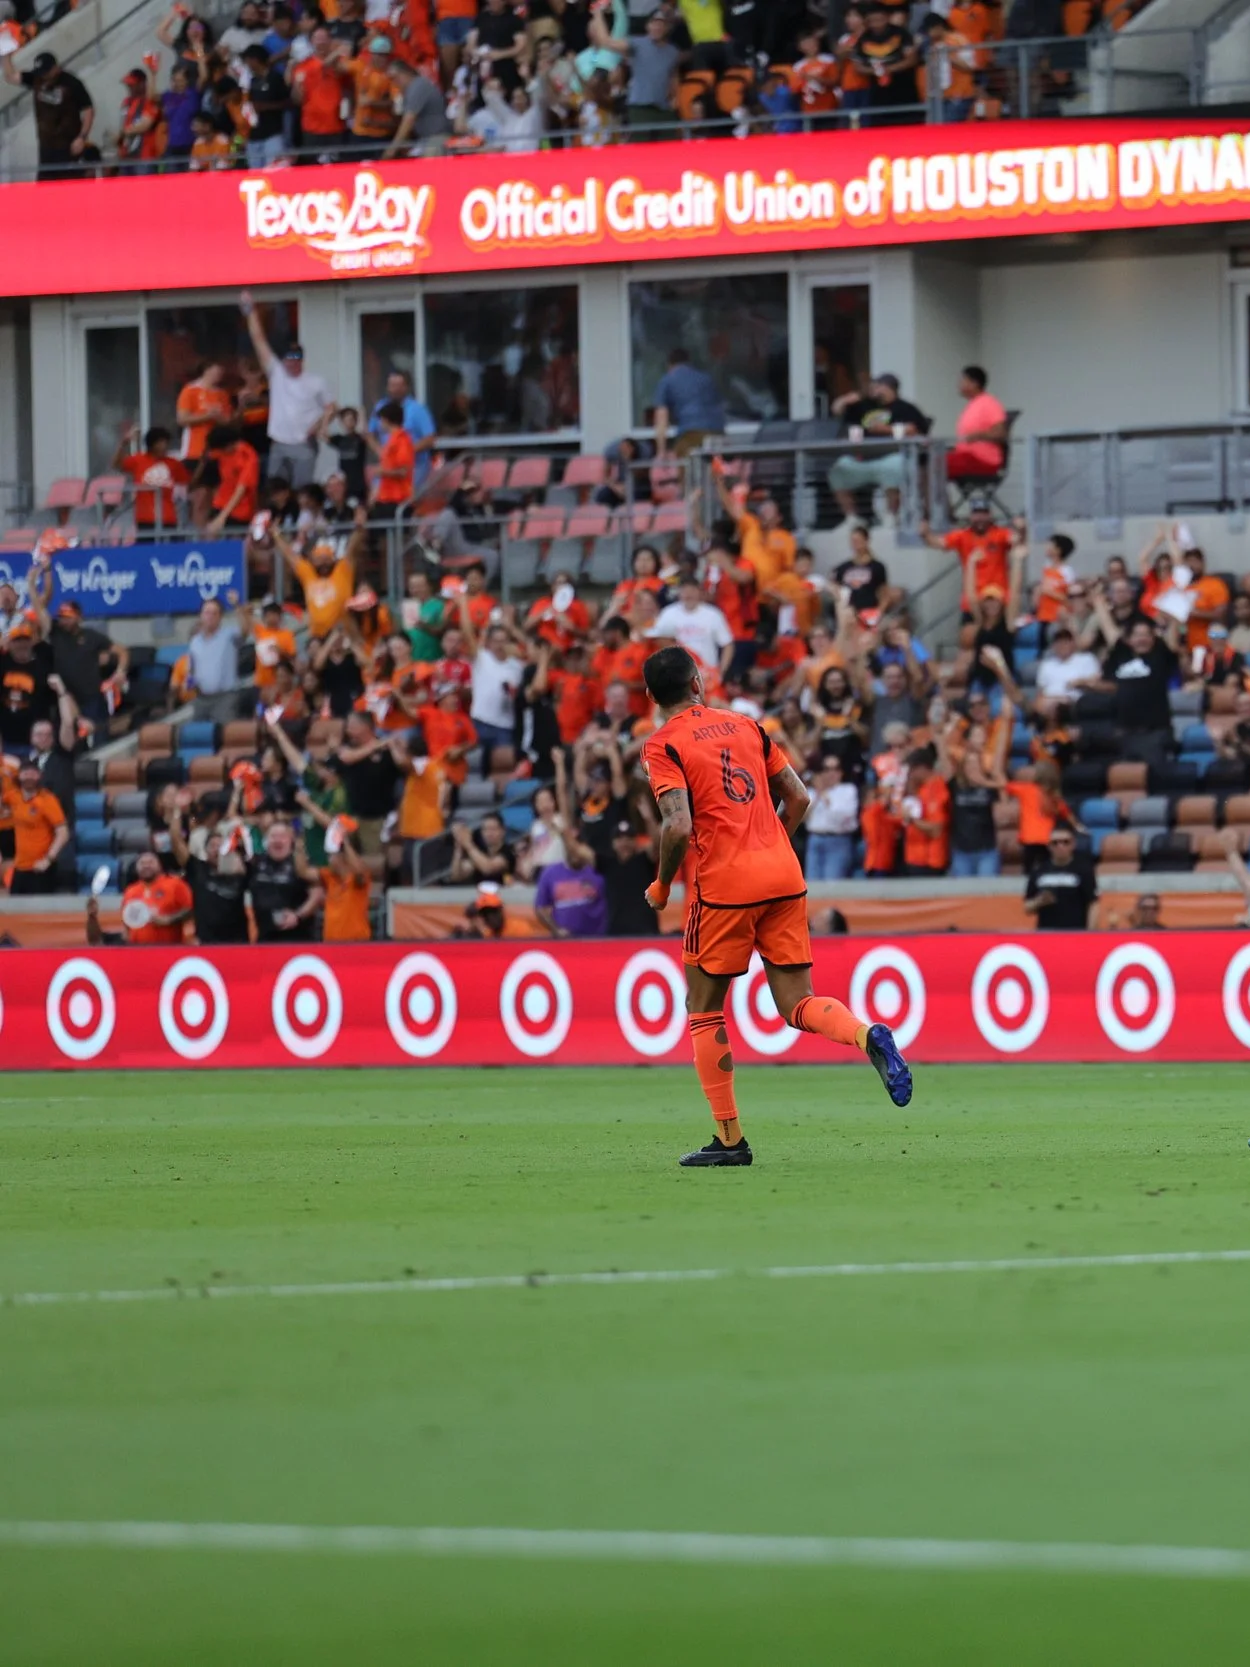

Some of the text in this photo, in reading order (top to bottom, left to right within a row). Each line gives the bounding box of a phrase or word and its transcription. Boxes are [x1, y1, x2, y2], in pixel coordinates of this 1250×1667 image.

[239, 171, 431, 246] Texas Bay
[460, 177, 598, 242] Official
[604, 170, 718, 231] Credit
[724, 170, 835, 224] Union
[844, 156, 890, 217] of
[892, 144, 1109, 214] HOUSTON
[82, 556, 137, 605] Kroger
[177, 551, 235, 600] Kroger
[692, 721, 740, 742] ARTUR
[720, 747, 756, 804] 6
